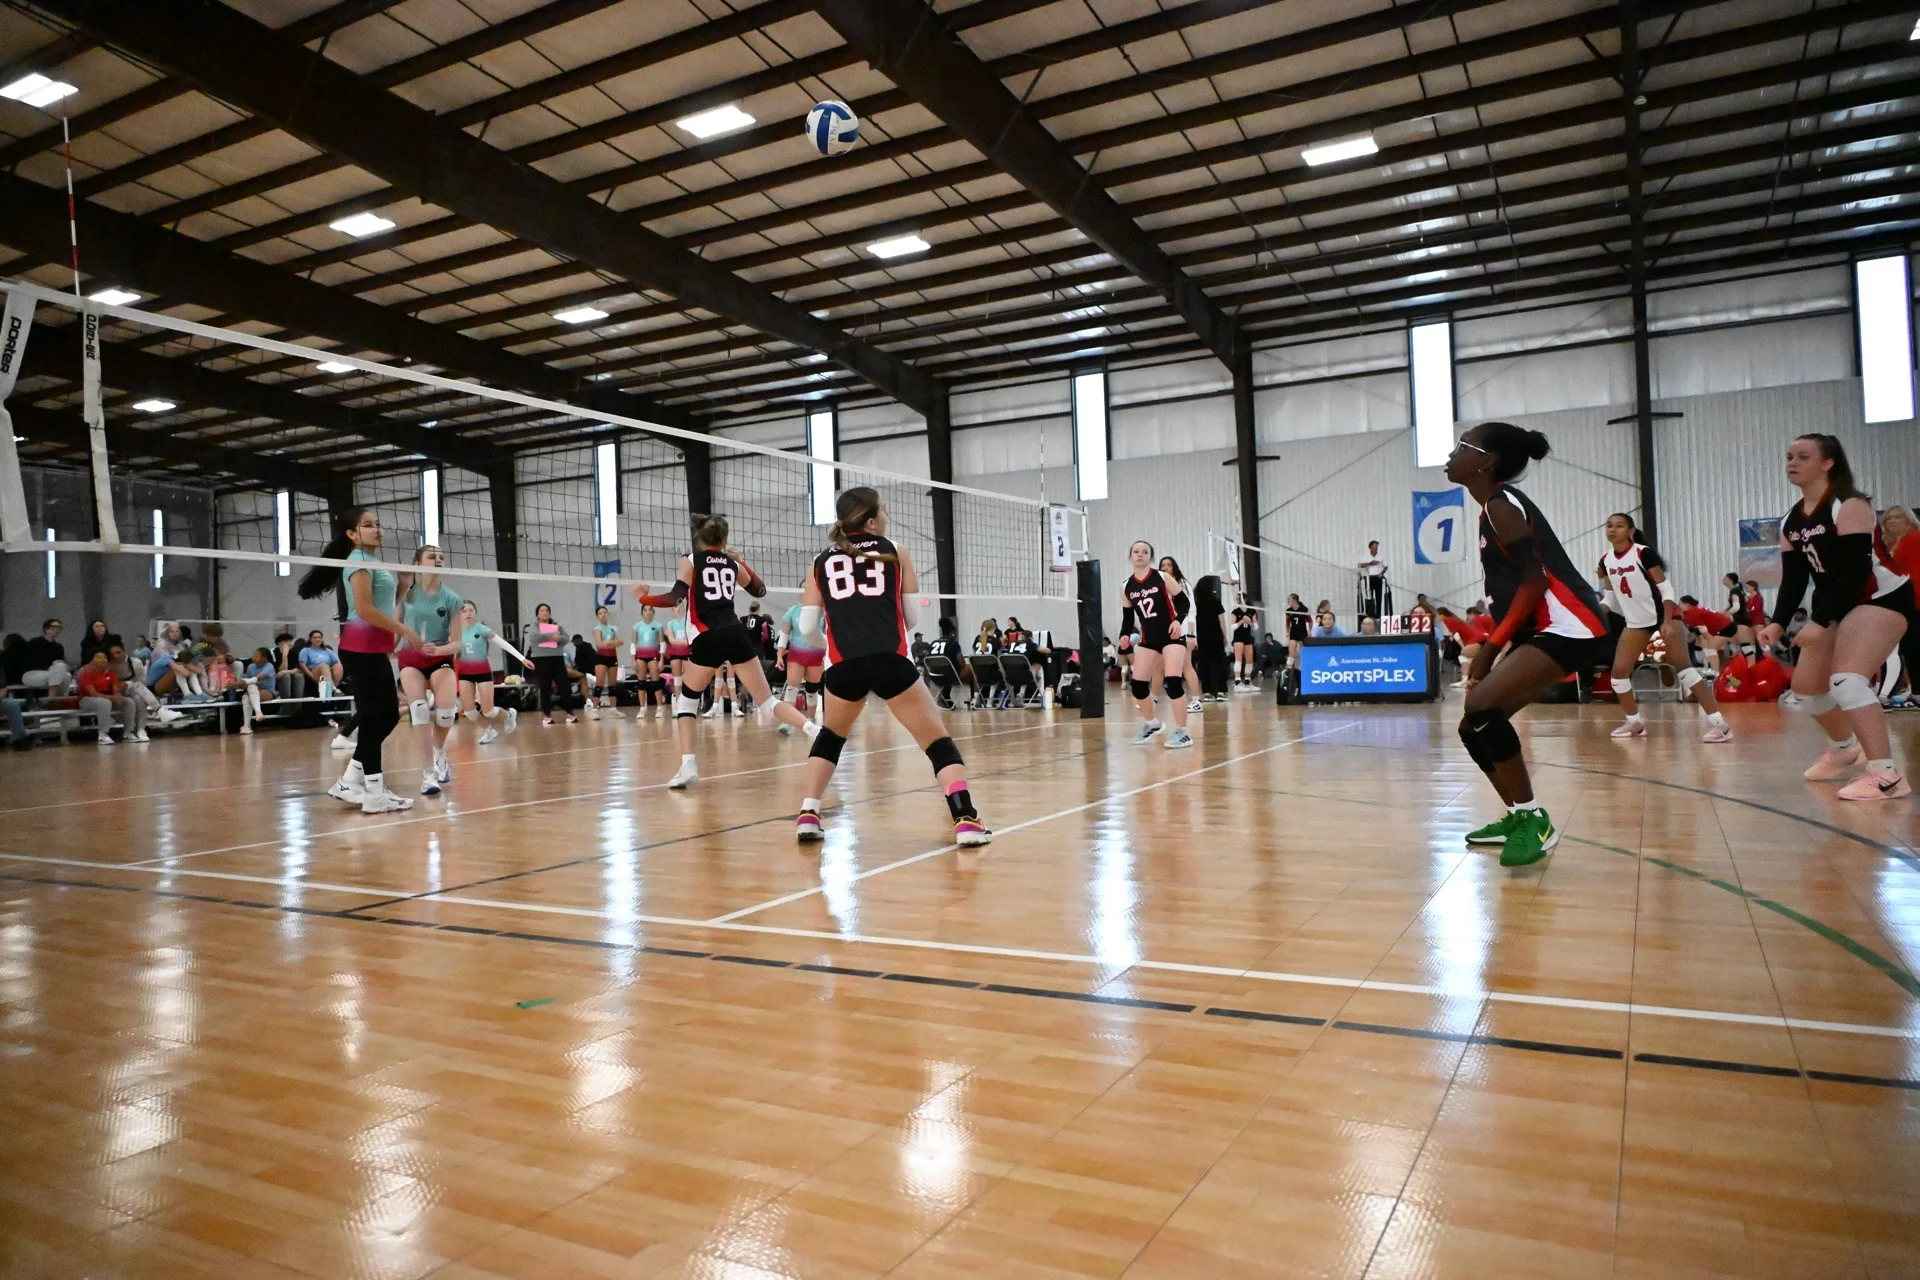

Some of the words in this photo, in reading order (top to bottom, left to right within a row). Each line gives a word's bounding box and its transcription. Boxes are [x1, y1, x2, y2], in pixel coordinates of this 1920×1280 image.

[1437, 517, 1453, 552] 1
[1057, 535, 1064, 557] 2
[702, 567, 735, 600] 98
[825, 551, 885, 600] 83
[603, 584, 617, 605] 2
[1620, 576, 1633, 598] 4
[1137, 597, 1157, 618] 12
[1411, 616, 1431, 632] 22
[930, 642, 946, 654] 21
